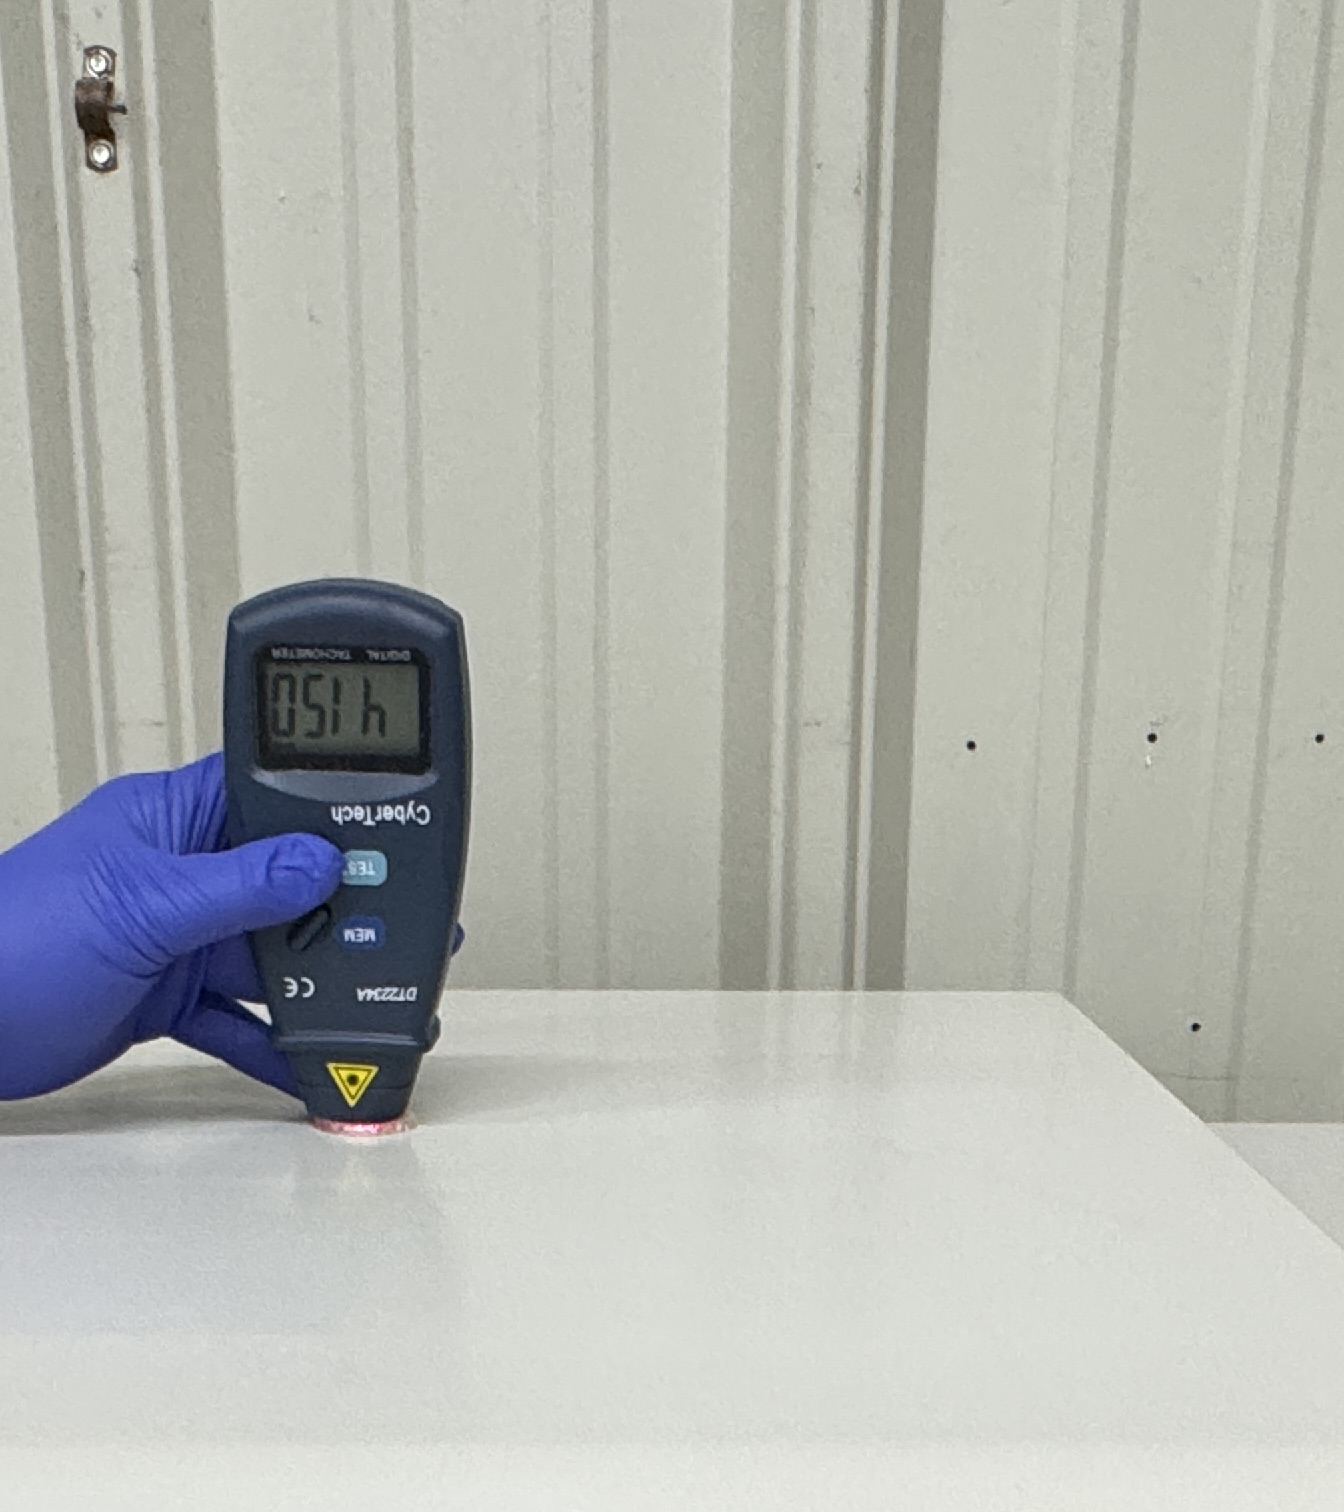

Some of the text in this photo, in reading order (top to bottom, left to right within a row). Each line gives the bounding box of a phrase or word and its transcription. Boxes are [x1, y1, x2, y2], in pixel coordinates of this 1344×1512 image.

[271, 672, 387, 739] 4150
[330, 800, 432, 826] CyberTech
[344, 928, 376, 942] MEM
[356, 986, 418, 1002] DT2234A
